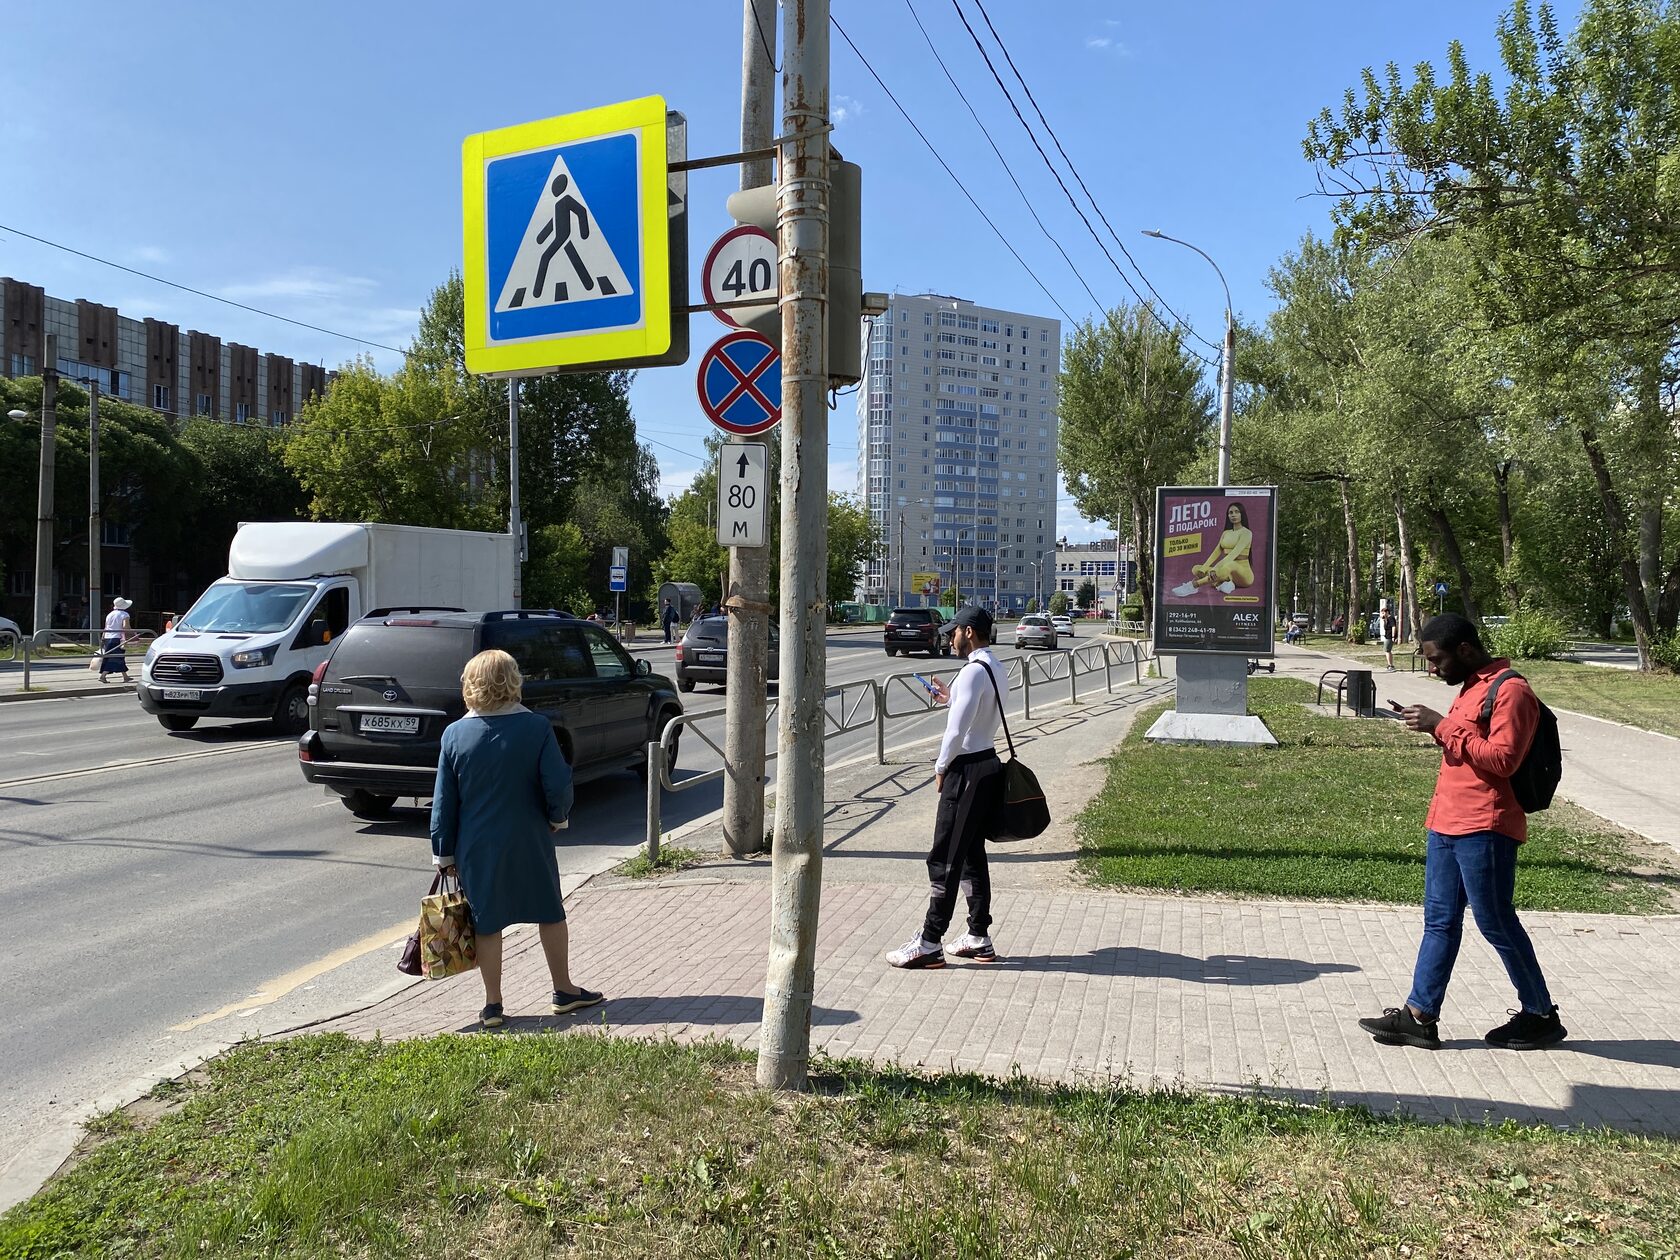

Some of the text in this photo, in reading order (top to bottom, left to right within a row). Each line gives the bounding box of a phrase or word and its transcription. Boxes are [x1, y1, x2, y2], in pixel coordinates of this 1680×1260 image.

[722, 258, 771, 297] 40
[728, 485, 755, 509] 80
[1170, 501, 1211, 524] ЛЕТО
[1169, 518, 1217, 533] В ПОДАРОК!
[1090, 541, 1116, 550] PERM
[1169, 538, 1189, 546] ТОЛЬКО
[1168, 546, 1176, 554] ДО
[1233, 613, 1259, 622] ALEX
[405, 717, 416, 726] 59
